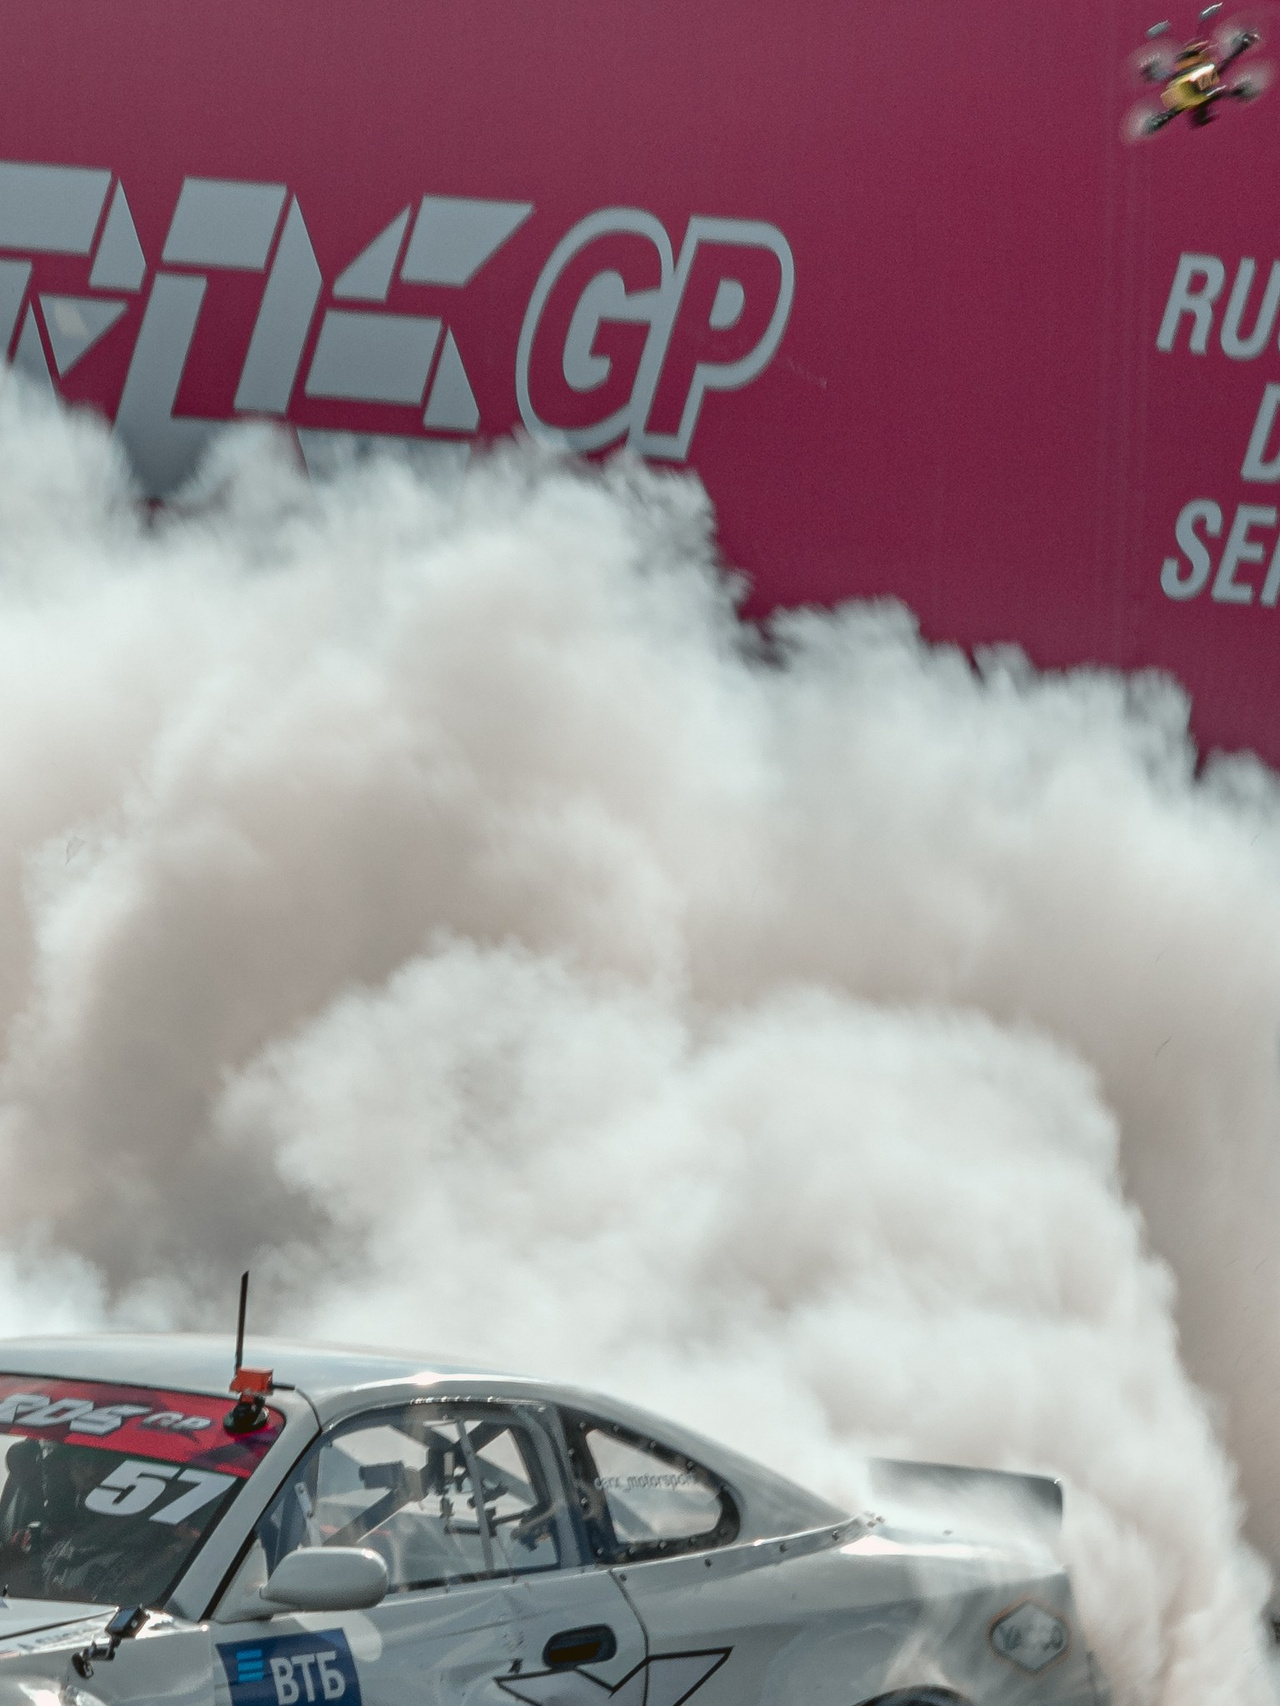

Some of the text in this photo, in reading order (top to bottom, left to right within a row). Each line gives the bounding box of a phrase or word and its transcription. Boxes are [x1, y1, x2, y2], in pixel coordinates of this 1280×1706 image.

[515, 206, 795, 460] GP
[1156, 252, 1280, 361] RU
[84, 1459, 238, 1526] 57
[270, 1650, 347, 1706] ВТБ
